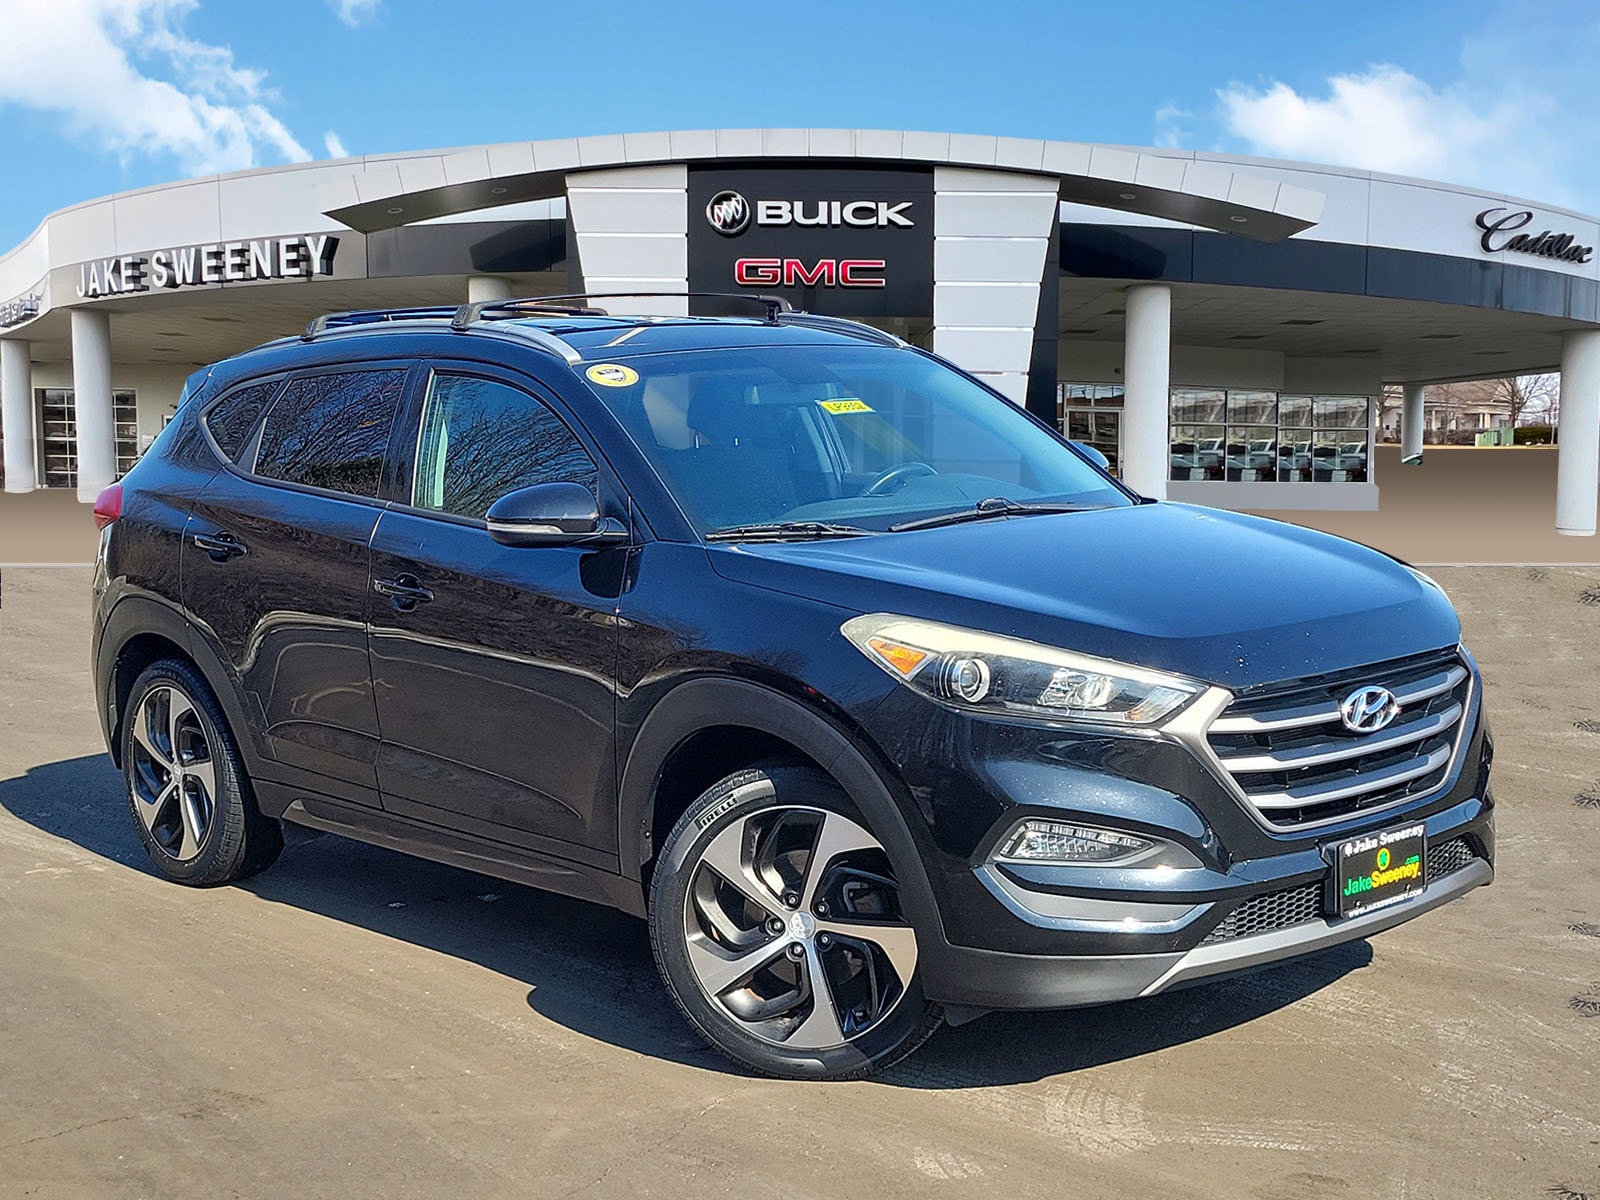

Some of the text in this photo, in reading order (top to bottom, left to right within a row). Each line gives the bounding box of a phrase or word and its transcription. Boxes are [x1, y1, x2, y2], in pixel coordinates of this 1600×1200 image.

[757, 200, 914, 227] BUICK
[1475, 207, 1593, 263] Cadillac
[76, 235, 334, 297] JAKE SWEENEY
[734, 258, 886, 287] GMC
[694, 793, 738, 830] PIRELLI
[1353, 837, 1378, 854] Jake
